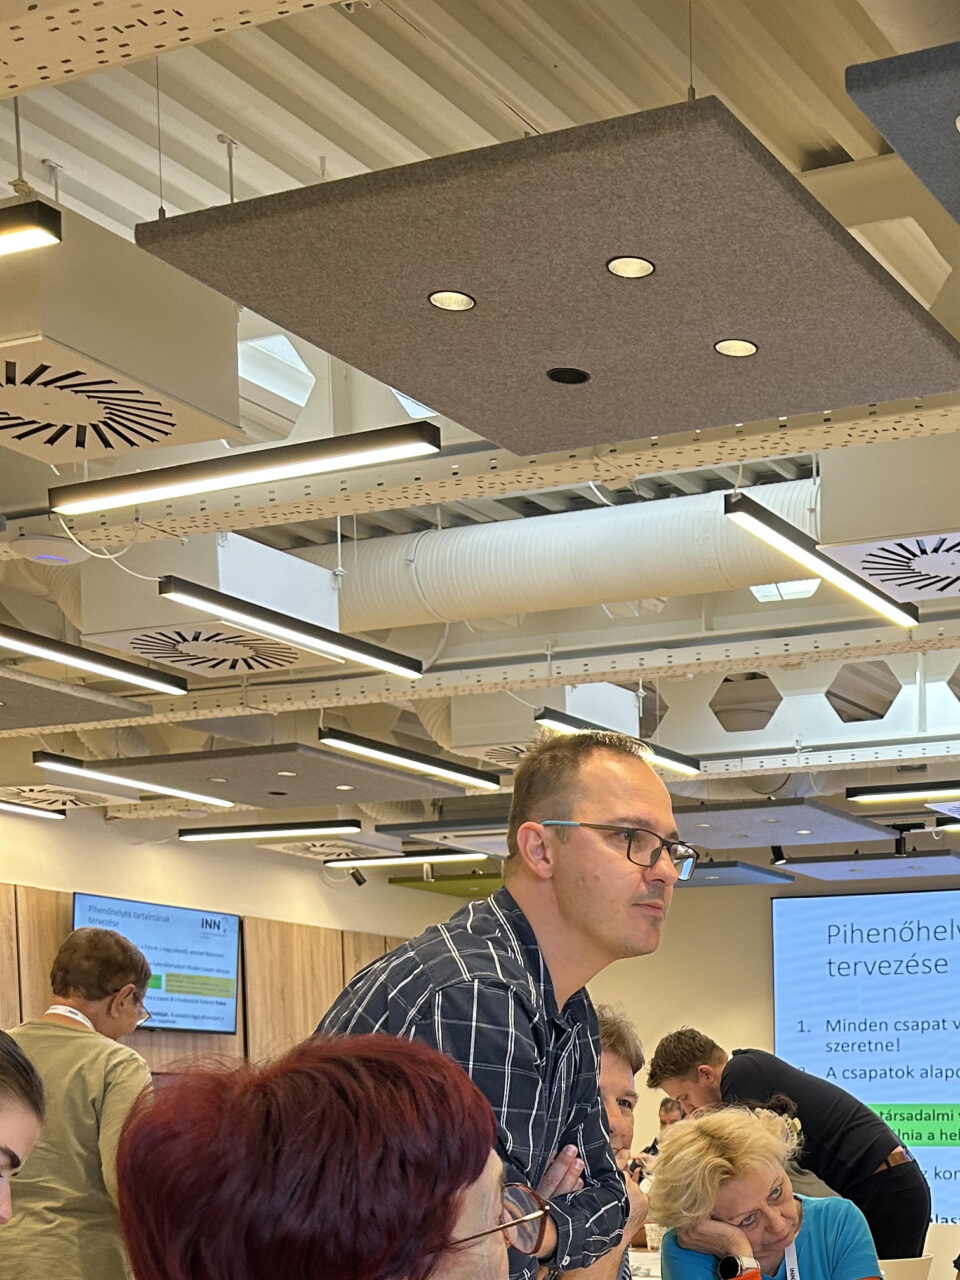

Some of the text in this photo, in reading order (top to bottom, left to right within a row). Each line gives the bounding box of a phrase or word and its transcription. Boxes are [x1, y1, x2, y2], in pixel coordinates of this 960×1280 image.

[826, 953, 949, 977] tervezése
[797, 1019, 812, 1033] 1.
[826, 1019, 888, 1033] Minden
[894, 1018, 948, 1034] csapat
[826, 1038, 900, 1052] szeretne!
[826, 1066, 837, 1080] A
[842, 1064, 914, 1081] csapatok
[879, 1109, 954, 1122] társadalmi
[927, 1132, 935, 1141] a
